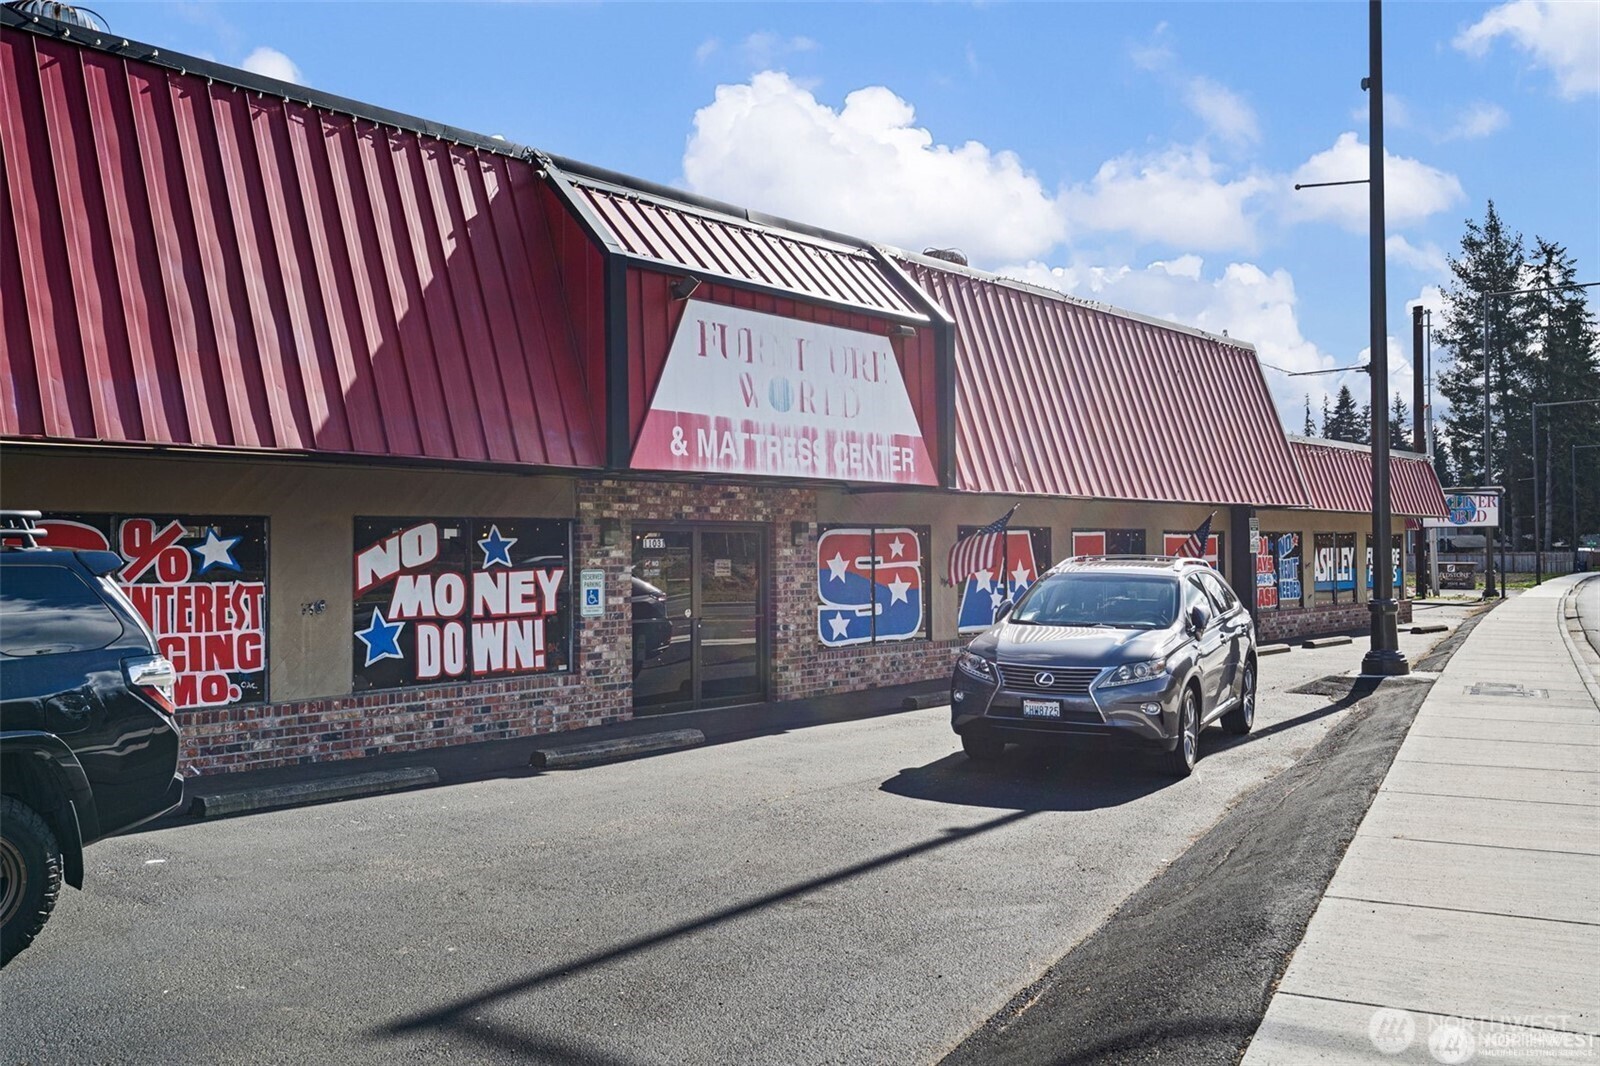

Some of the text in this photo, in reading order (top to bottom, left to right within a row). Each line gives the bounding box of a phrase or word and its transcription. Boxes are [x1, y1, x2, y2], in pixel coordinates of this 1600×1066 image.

[697, 320, 889, 384] FURIURE
[669, 426, 914, 473] & MATTRESS CENTER
[355, 521, 439, 595] NO
[1314, 547, 1354, 581] ASHLEY
[387, 567, 566, 620] MONEY
[415, 616, 546, 678] DOWN!
